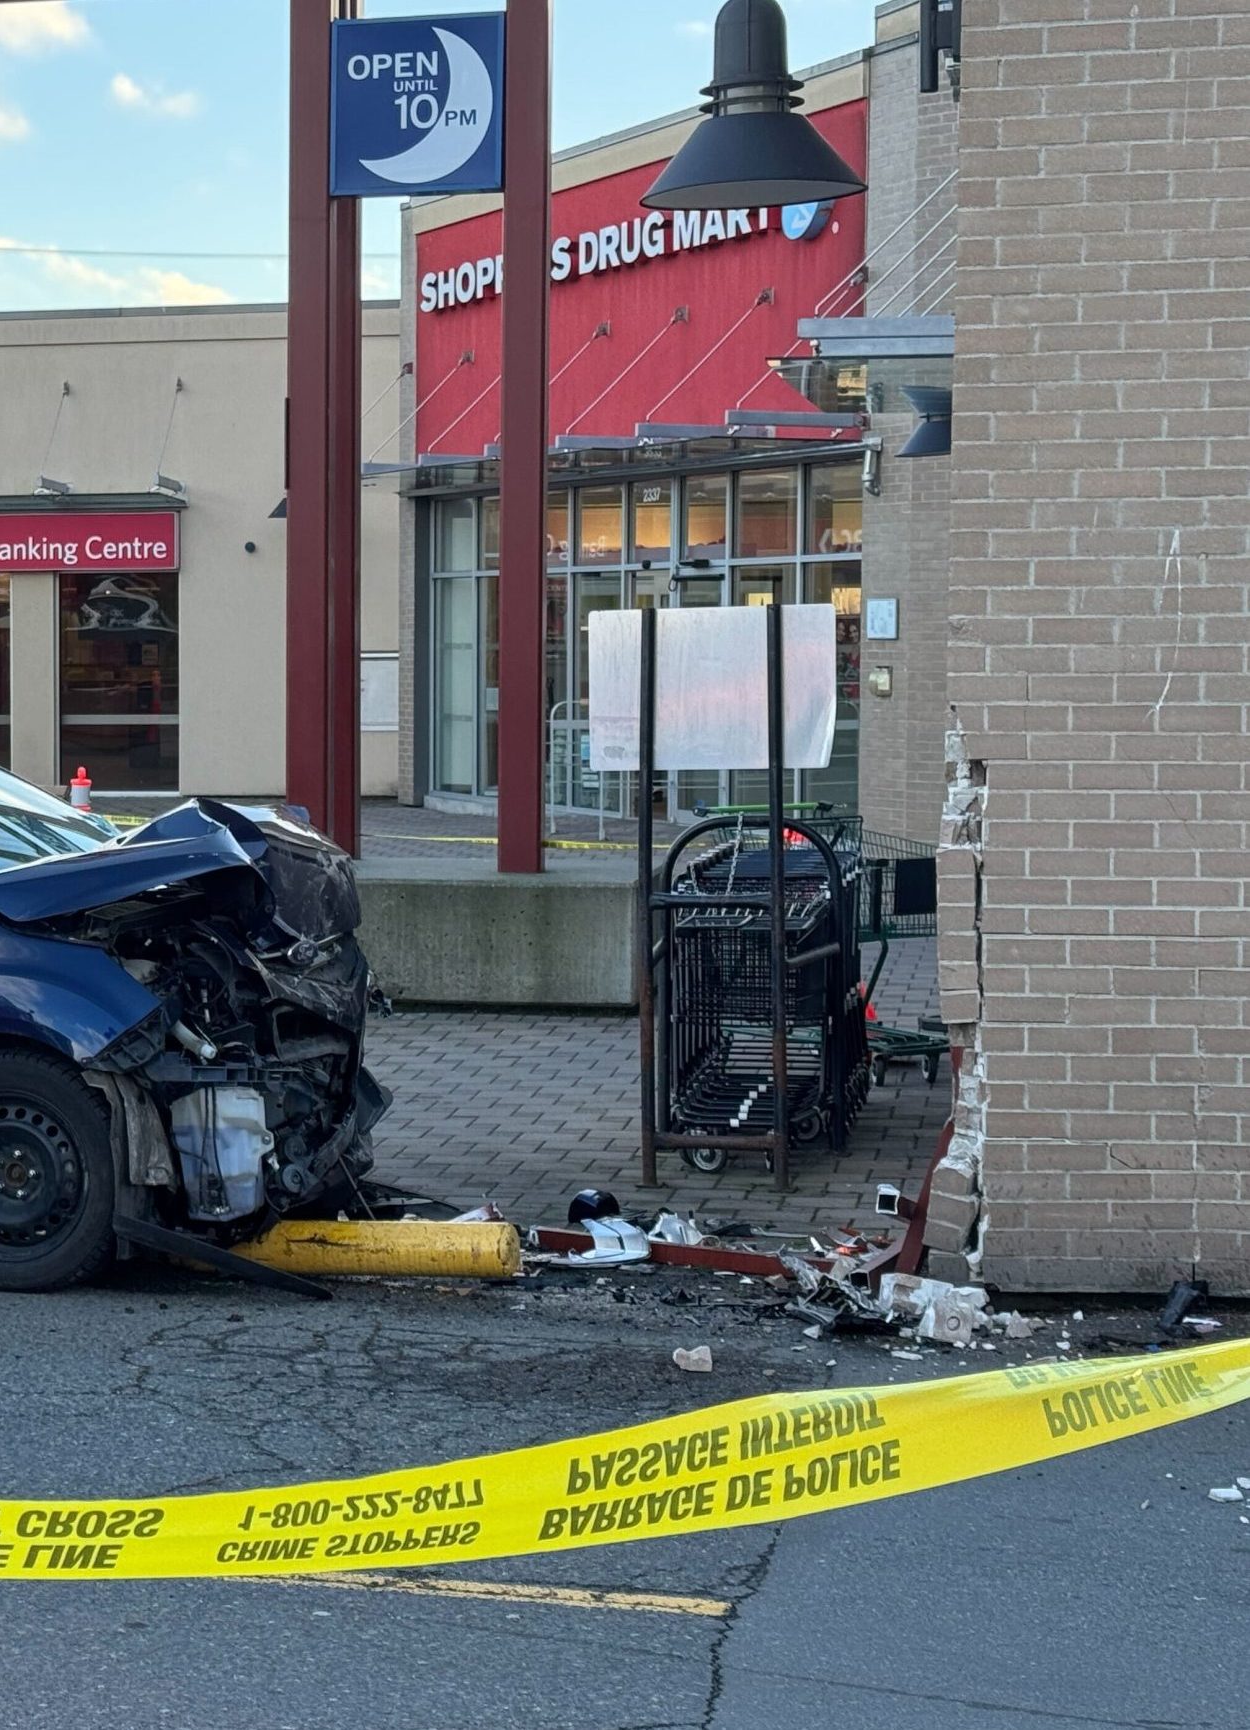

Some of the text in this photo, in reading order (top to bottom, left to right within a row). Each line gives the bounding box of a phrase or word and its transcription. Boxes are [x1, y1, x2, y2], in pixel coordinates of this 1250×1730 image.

[347, 50, 439, 80] OPEN
[393, 79, 439, 93] UNTIL
[394, 93, 477, 130] 10 PM
[420, 235, 572, 314] SHOPPS
[578, 211, 665, 276] DRUG
[642, 486, 662, 503] 2337
[84, 535, 168, 561] Centre
